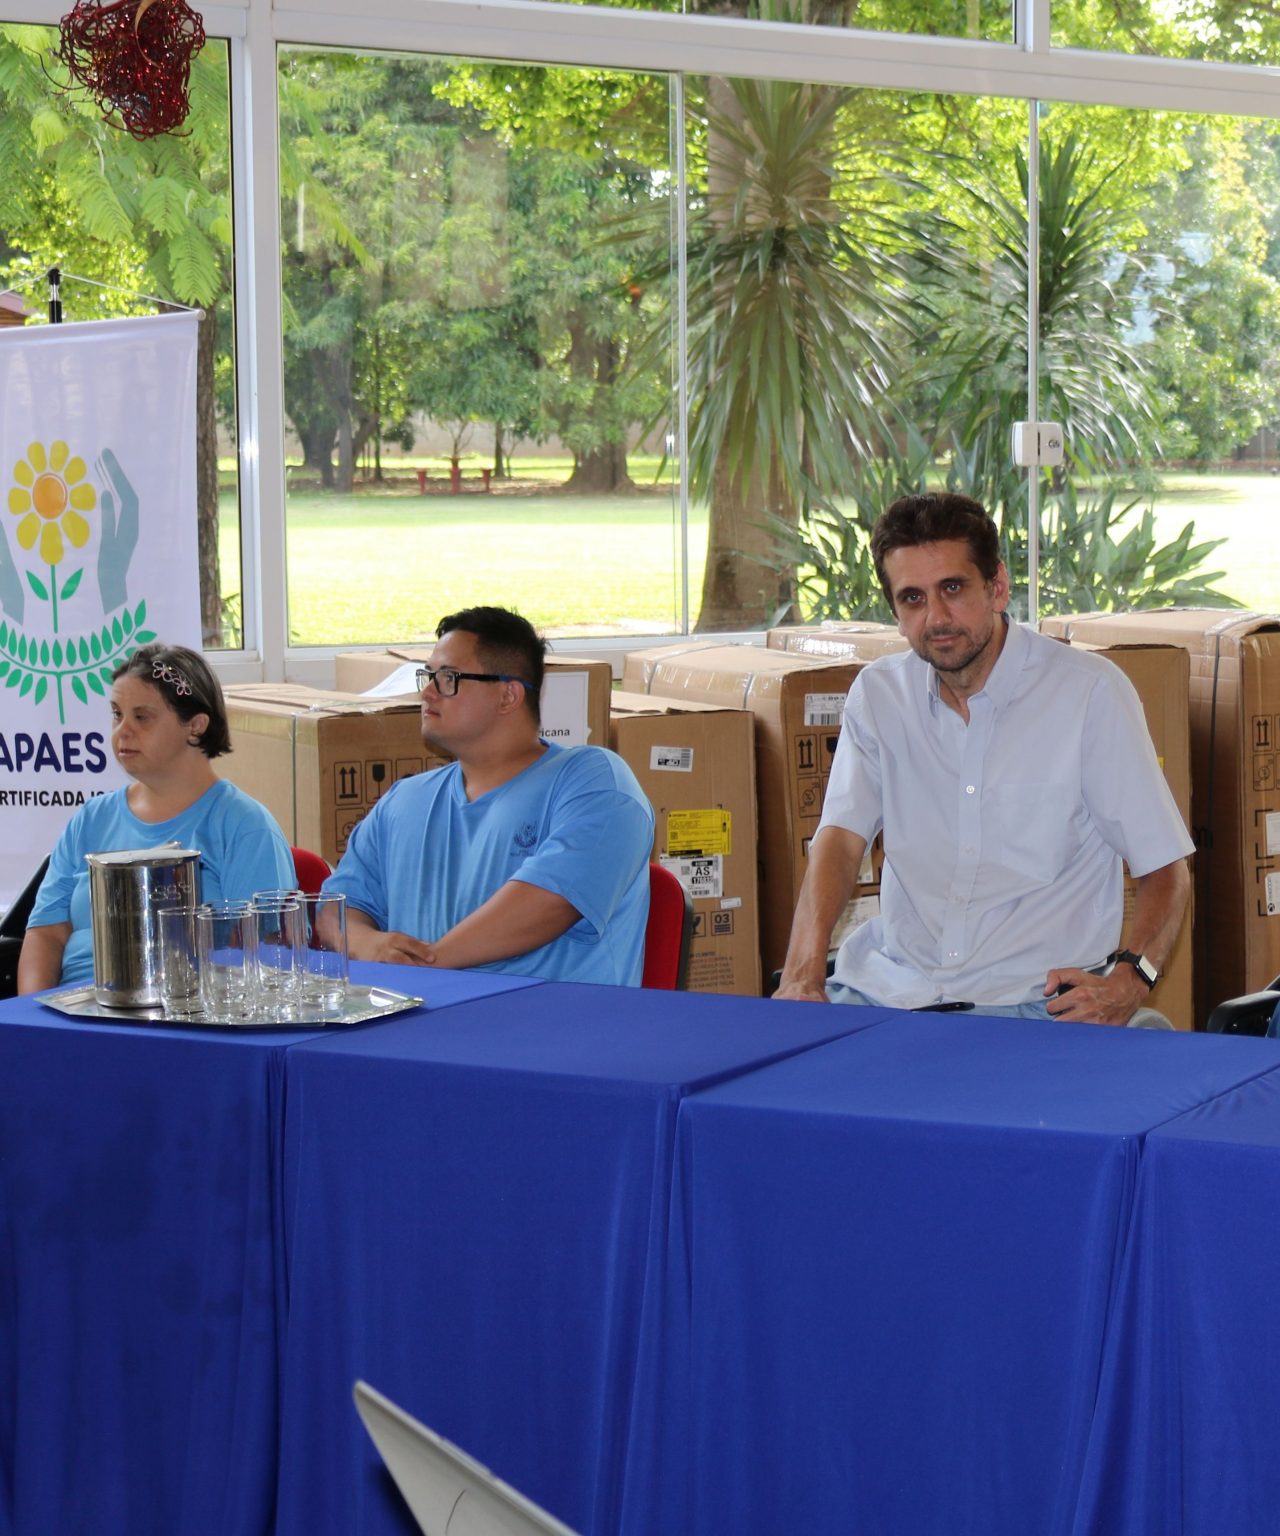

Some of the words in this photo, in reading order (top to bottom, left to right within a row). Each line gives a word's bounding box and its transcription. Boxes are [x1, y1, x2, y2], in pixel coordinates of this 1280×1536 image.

[538, 728, 570, 737] icana
[695, 866, 710, 876] AS
[714, 913, 730, 924] 03
